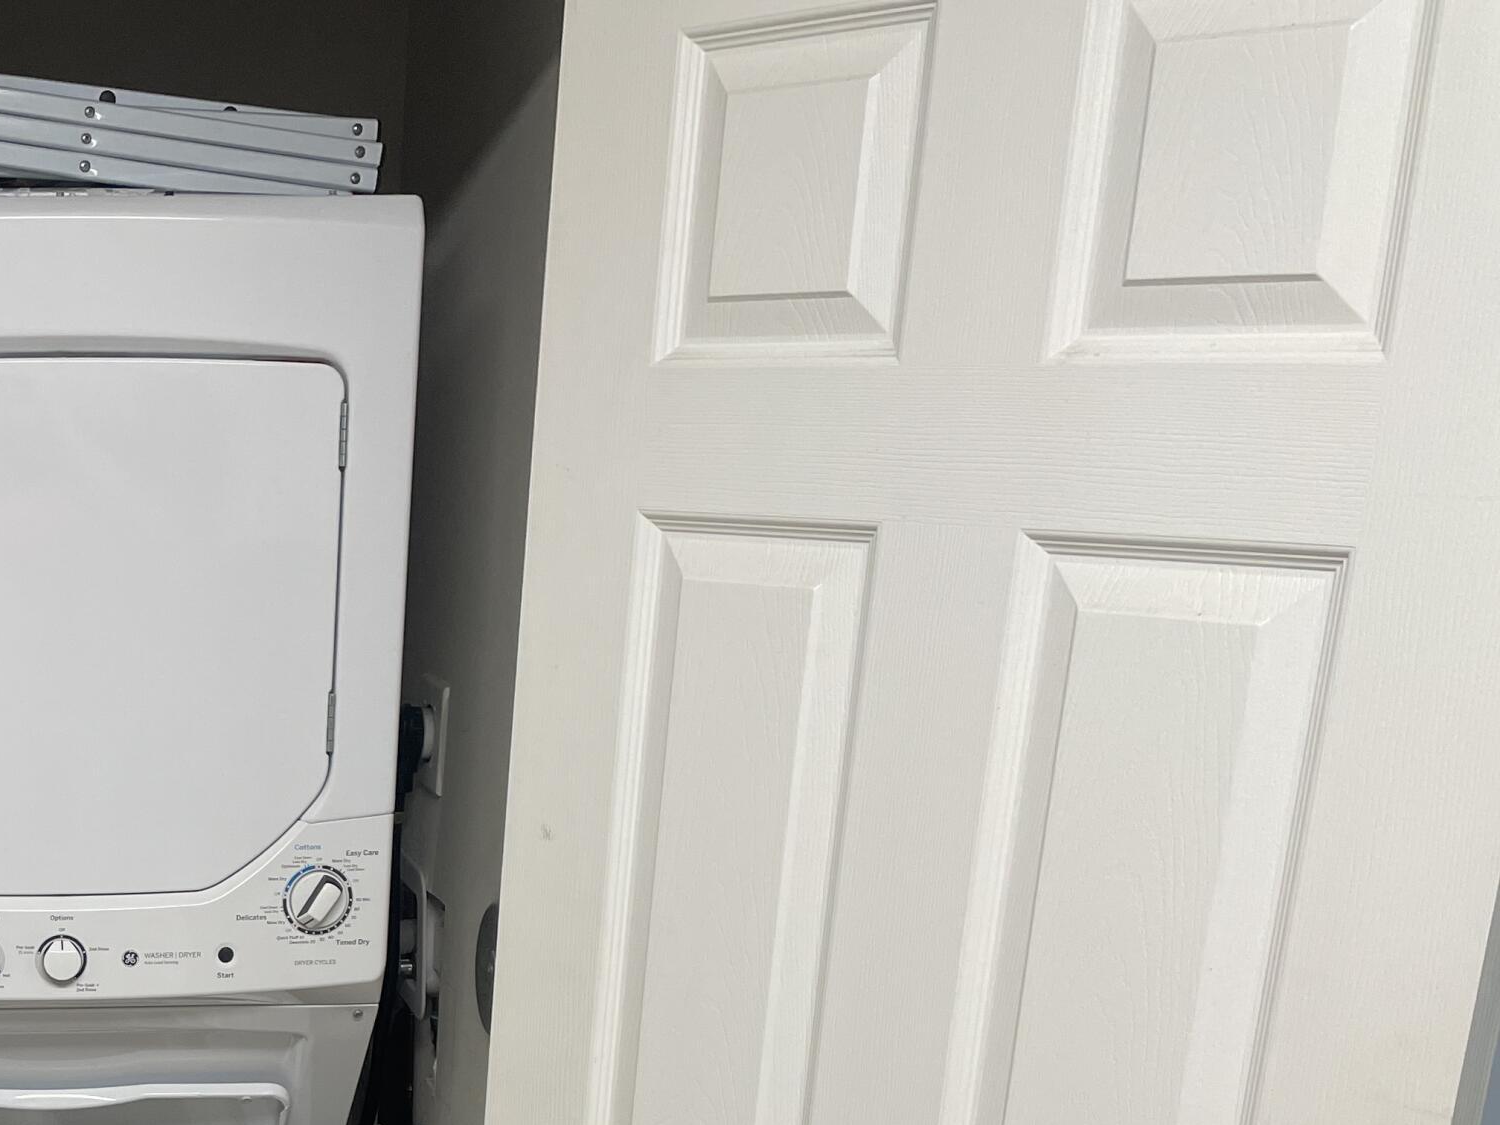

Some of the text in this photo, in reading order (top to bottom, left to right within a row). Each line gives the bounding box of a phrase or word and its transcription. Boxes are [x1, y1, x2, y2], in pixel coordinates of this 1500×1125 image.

[346, 849, 362, 857] Easy
[144, 951, 202, 959] WASHER DRYER
